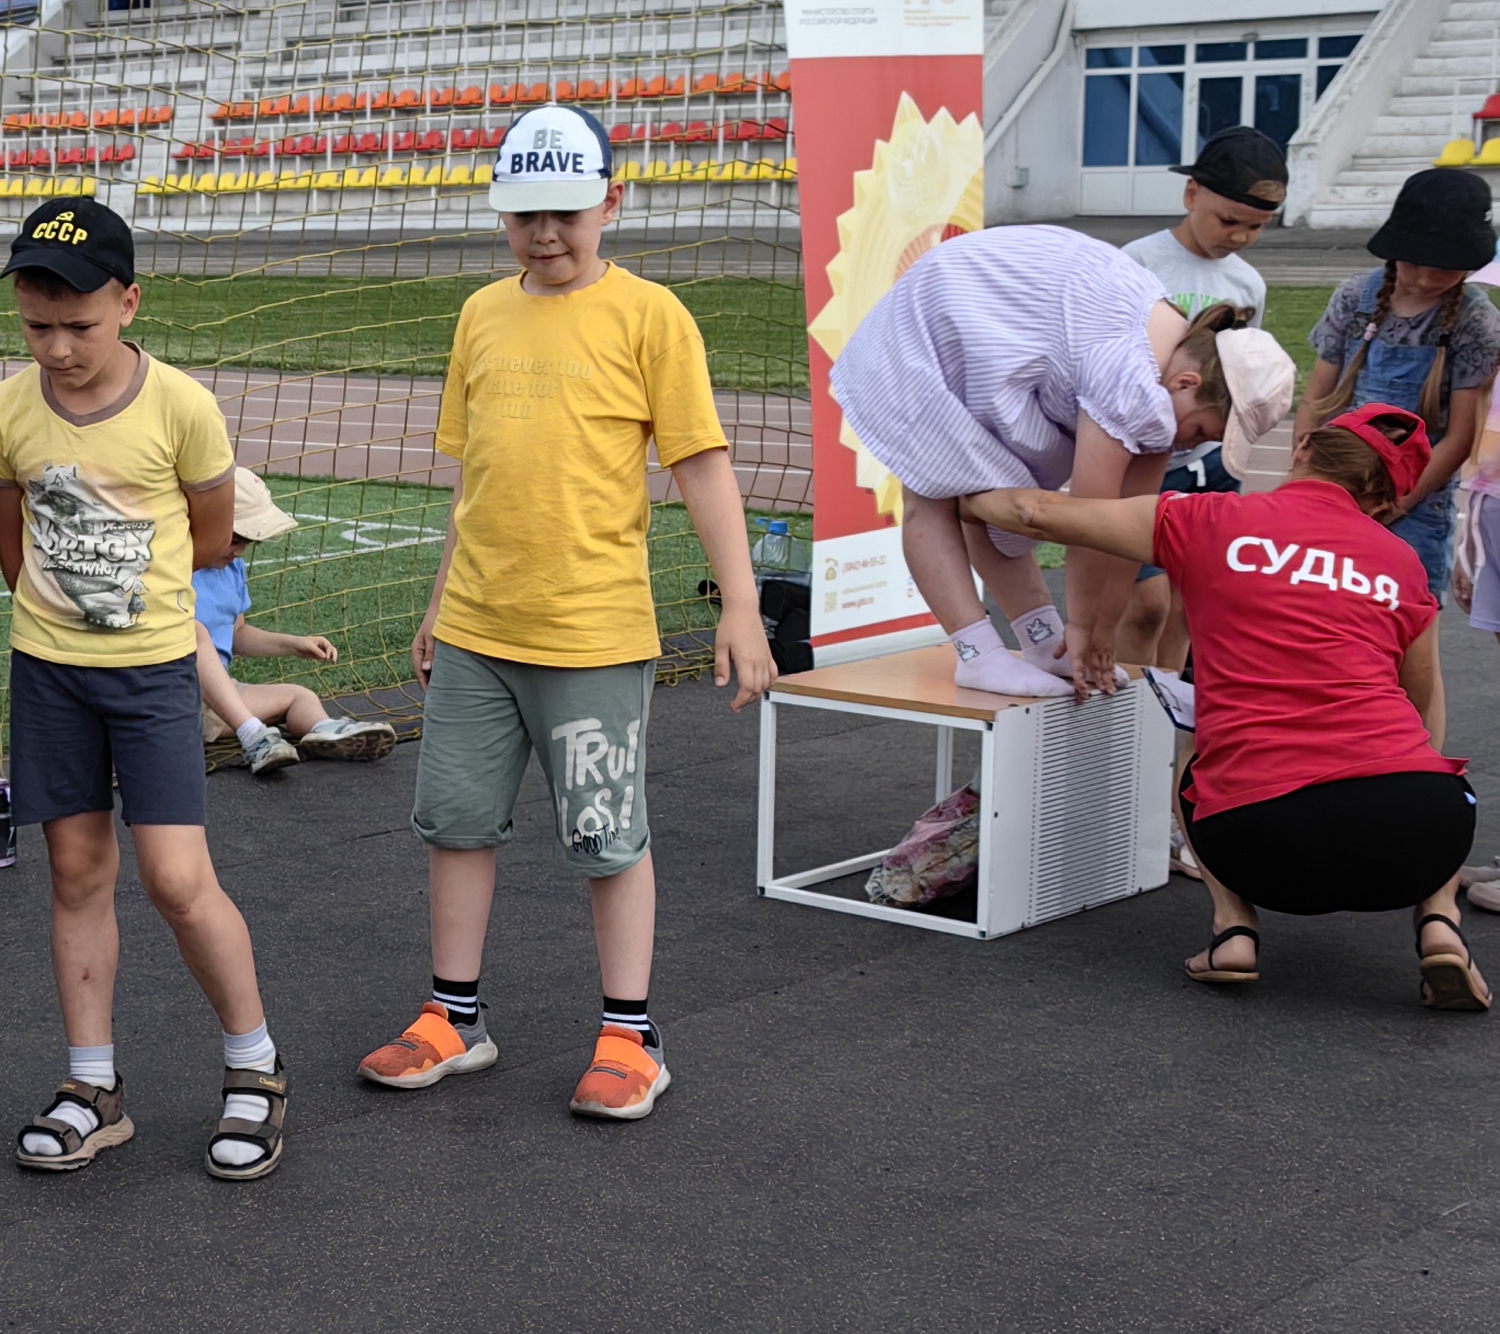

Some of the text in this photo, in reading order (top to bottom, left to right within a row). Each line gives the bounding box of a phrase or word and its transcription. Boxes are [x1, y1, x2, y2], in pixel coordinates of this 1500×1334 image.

[533, 128, 563, 150] BE
[510, 151, 585, 175] BRAVE
[1226, 536, 1400, 611] СУДЬЯ
